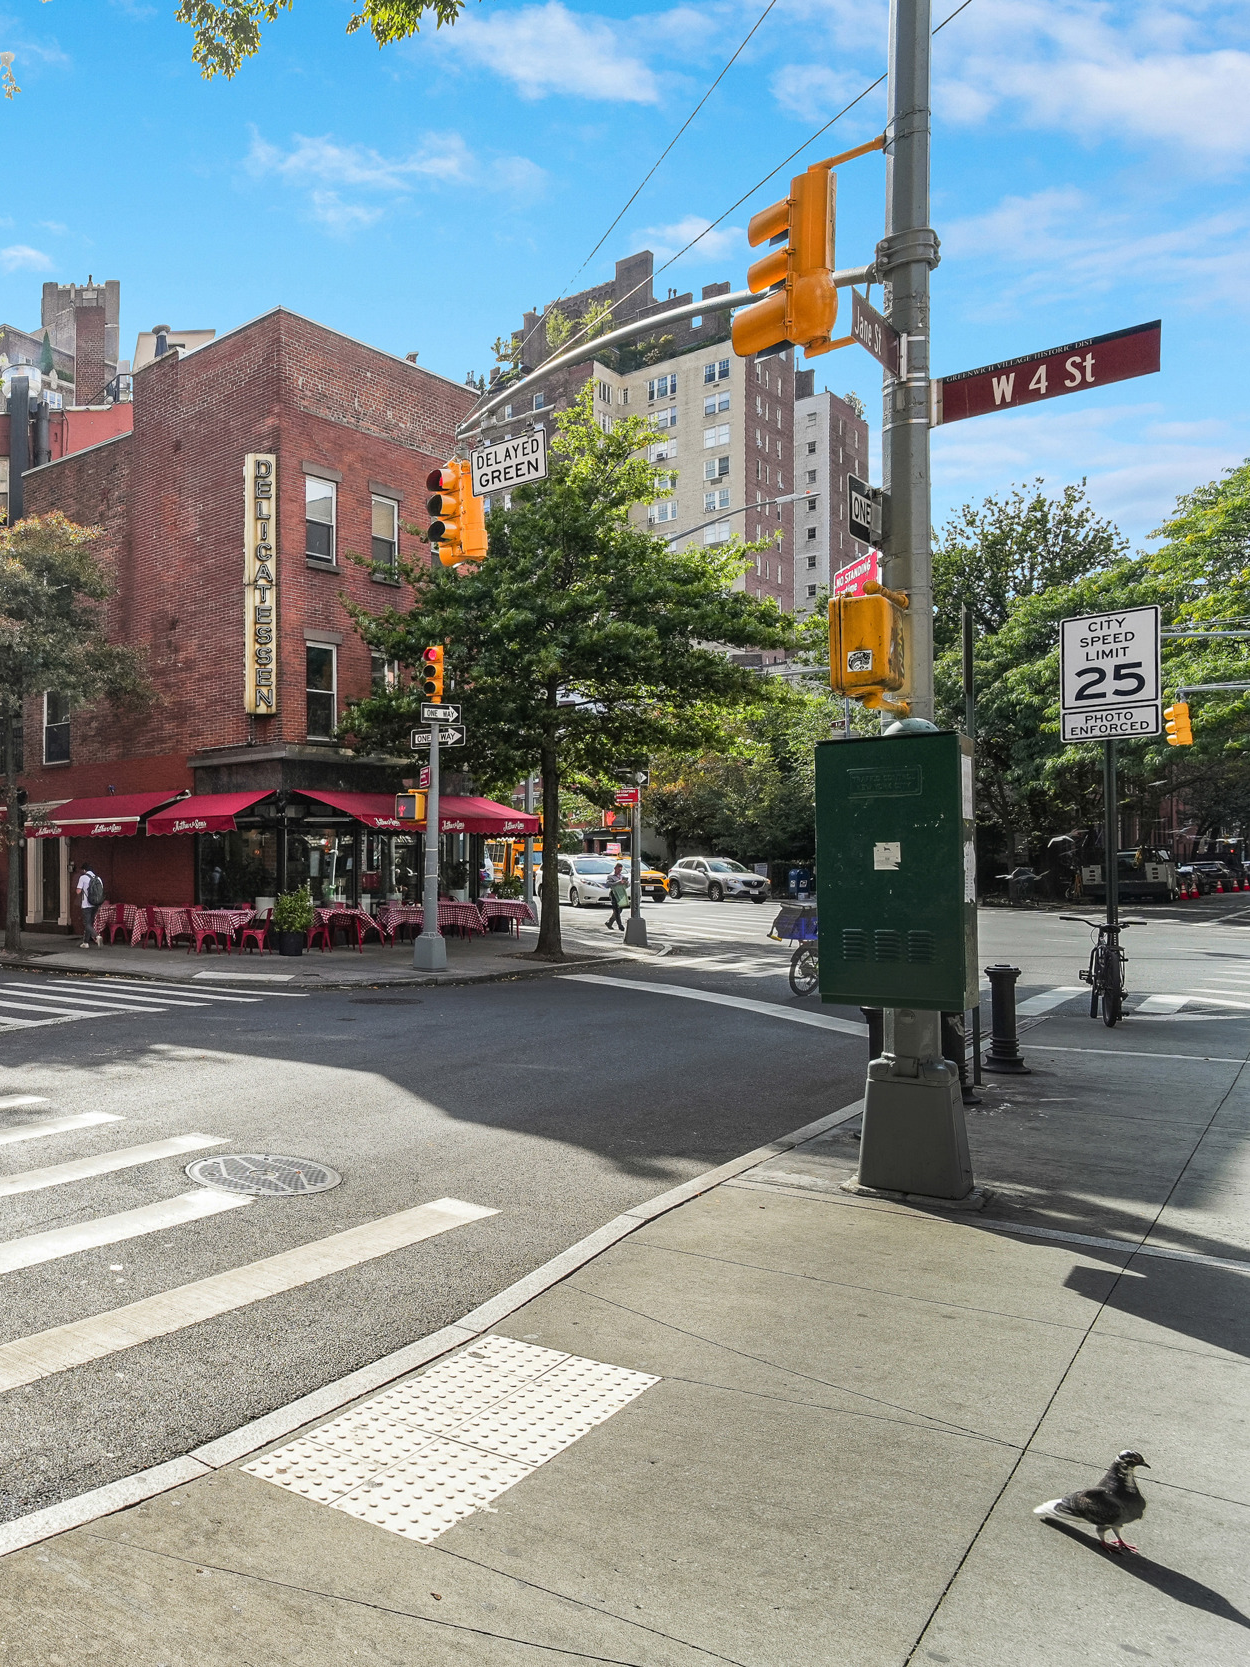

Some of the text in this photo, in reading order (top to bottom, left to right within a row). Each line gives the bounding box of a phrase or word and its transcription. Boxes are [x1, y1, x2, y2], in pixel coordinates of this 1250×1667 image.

[854, 305, 882, 356] Jane St
[946, 338, 1094, 382] GREENWICH VILLAGE HISTORIC DIST
[991, 352, 1096, 406] W 4 St
[476, 438, 539, 470] DELAYED
[479, 458, 539, 488] GREEN
[853, 496, 871, 526] ONE
[255, 459, 273, 707] DELICATESSEN
[836, 562, 871, 589] NO STANDING
[1088, 617, 1126, 632] CITY
[1079, 631, 1135, 648] SPEED
[1085, 646, 1130, 662] LIMIT
[1074, 661, 1146, 702] 25
[426, 709, 455, 718] ONE WAY
[1085, 711, 1134, 725] PHOTO
[416, 732, 456, 743] ONE WAY
[1070, 720, 1150, 736] ENFORCED
